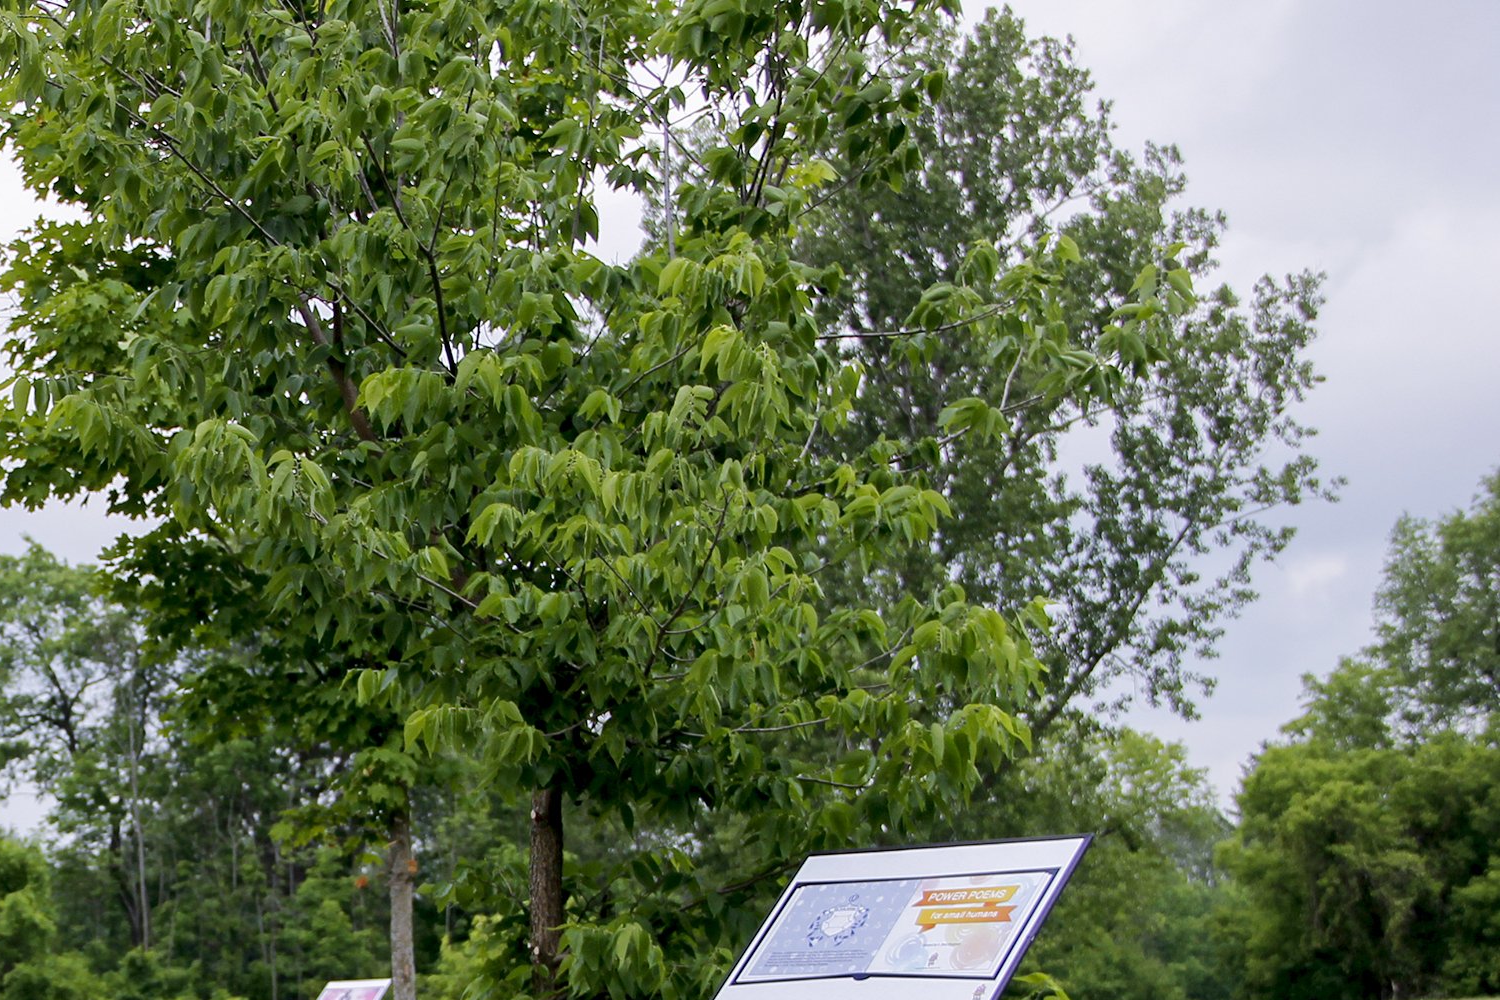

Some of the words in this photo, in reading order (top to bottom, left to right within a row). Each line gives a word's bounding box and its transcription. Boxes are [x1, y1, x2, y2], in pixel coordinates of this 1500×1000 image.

[928, 891, 967, 902] POWER
[968, 889, 1006, 900] POEMS
[930, 911, 943, 919] for
[943, 910, 966, 919] small
[966, 910, 998, 918] humans
